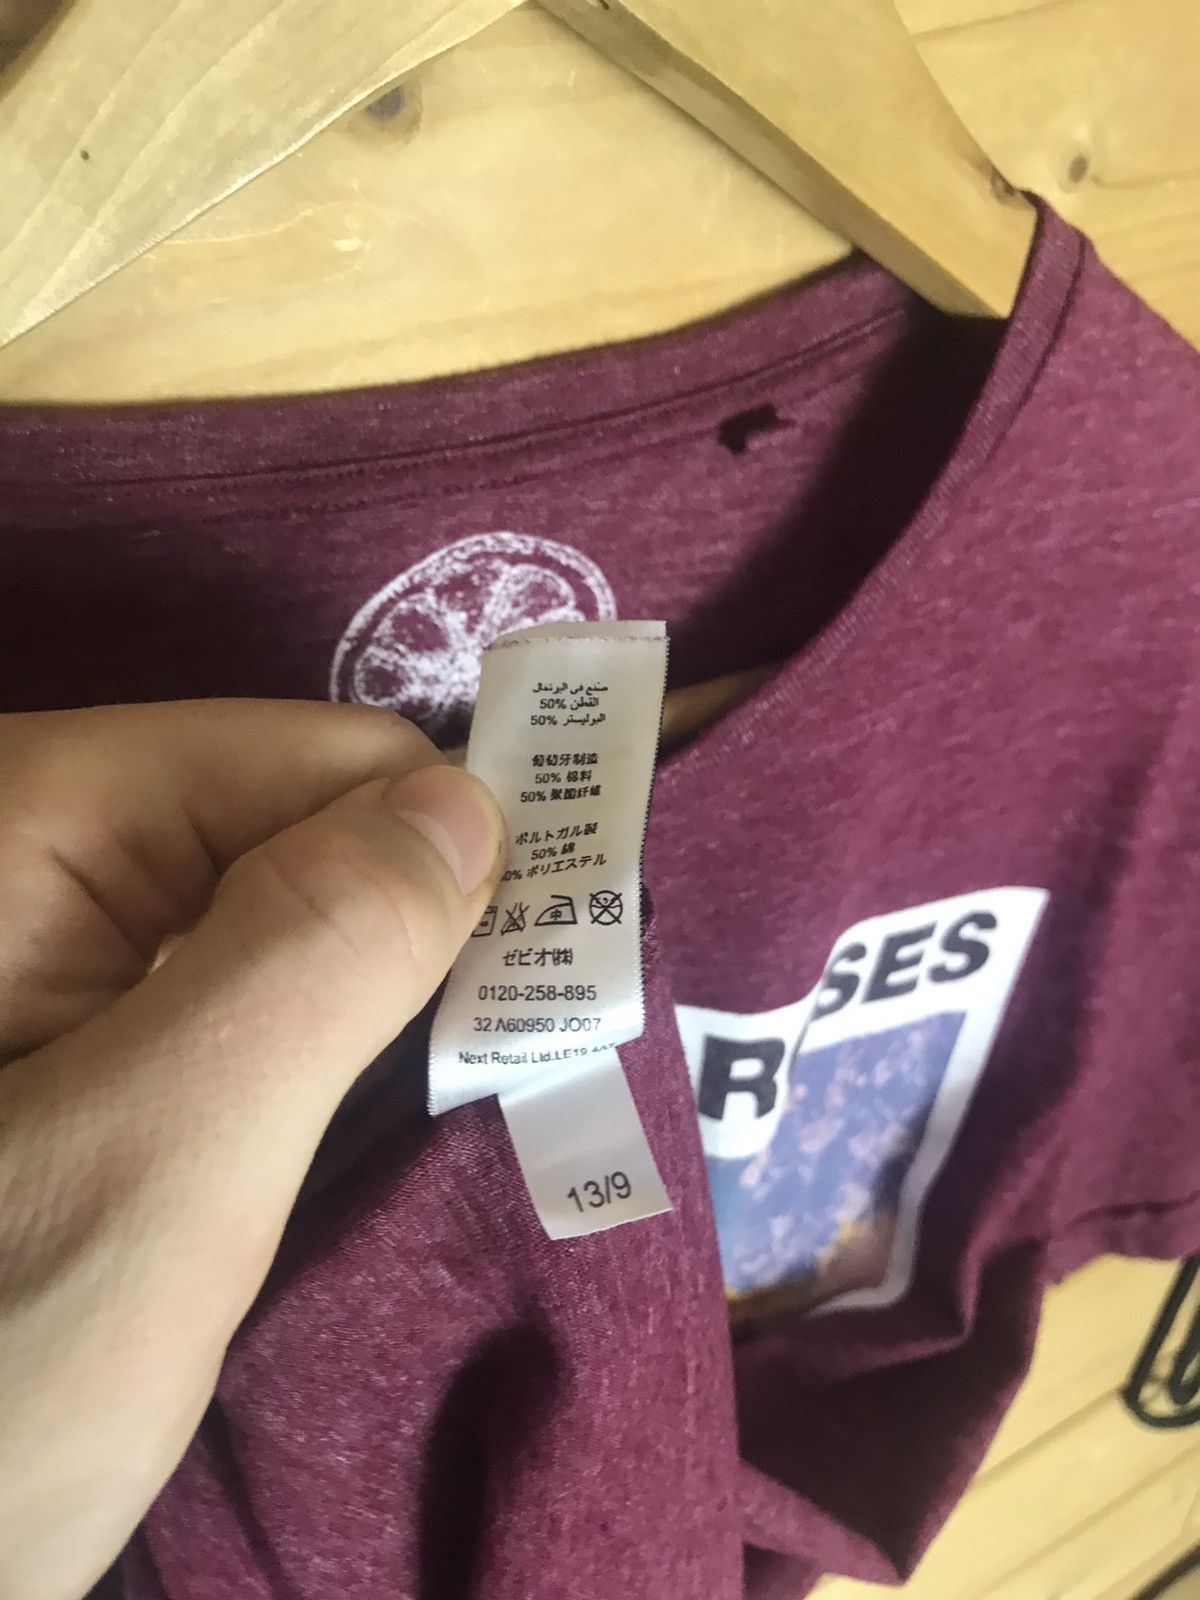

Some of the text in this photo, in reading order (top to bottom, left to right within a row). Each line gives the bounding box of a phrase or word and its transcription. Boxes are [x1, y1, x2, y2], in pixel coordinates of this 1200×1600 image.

[539, 698, 567, 709] 50%
[530, 715, 558, 725] 50%
[535, 772, 562, 784] 50%
[520, 790, 547, 802] 50%
[531, 846, 558, 861] 50%
[501, 869, 523, 882] 0%
[478, 984, 597, 1001] 0120-258-895
[473, 1017, 491, 1032] 32
[458, 1051, 488, 1065] Next
[491, 1051, 528, 1065] Retail
[567, 1171, 632, 1213] 13/9
